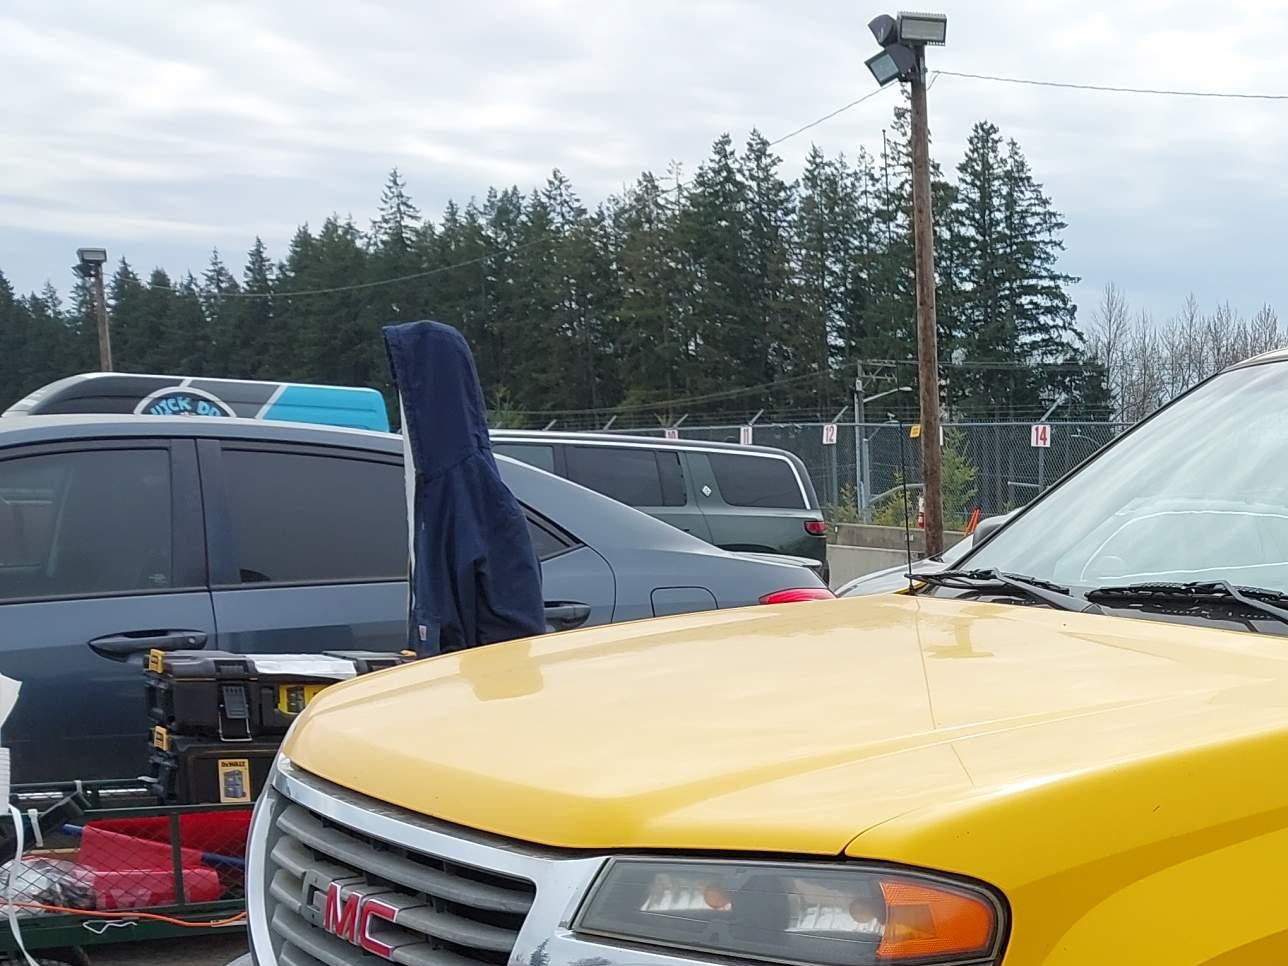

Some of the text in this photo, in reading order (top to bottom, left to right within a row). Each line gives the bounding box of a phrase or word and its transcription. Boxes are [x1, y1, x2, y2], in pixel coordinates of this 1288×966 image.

[150, 396, 192, 415] UICK
[825, 426, 834, 443] 12
[1034, 426, 1047, 446] 14
[302, 869, 399, 961] GMC
